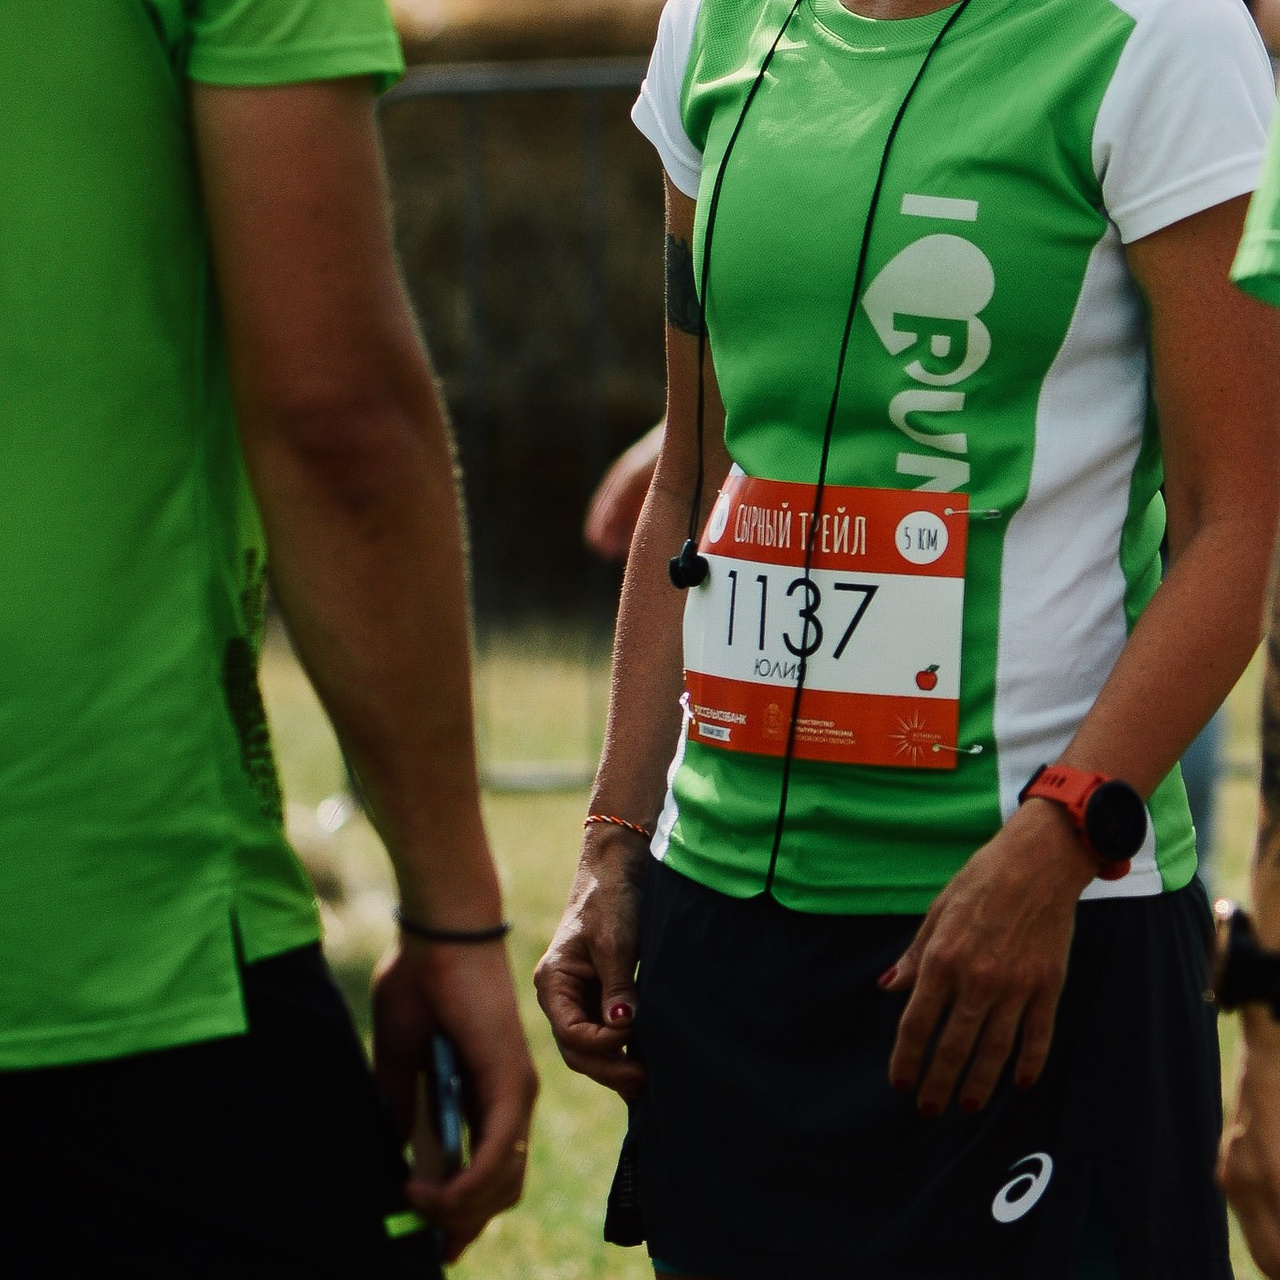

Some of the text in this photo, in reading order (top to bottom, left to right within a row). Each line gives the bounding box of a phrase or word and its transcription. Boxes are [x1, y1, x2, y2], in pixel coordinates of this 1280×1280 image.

[734, 502, 792, 549] СЫРНЫЙ
[904, 526, 911, 551] 5
[727, 570, 880, 660] 1137
